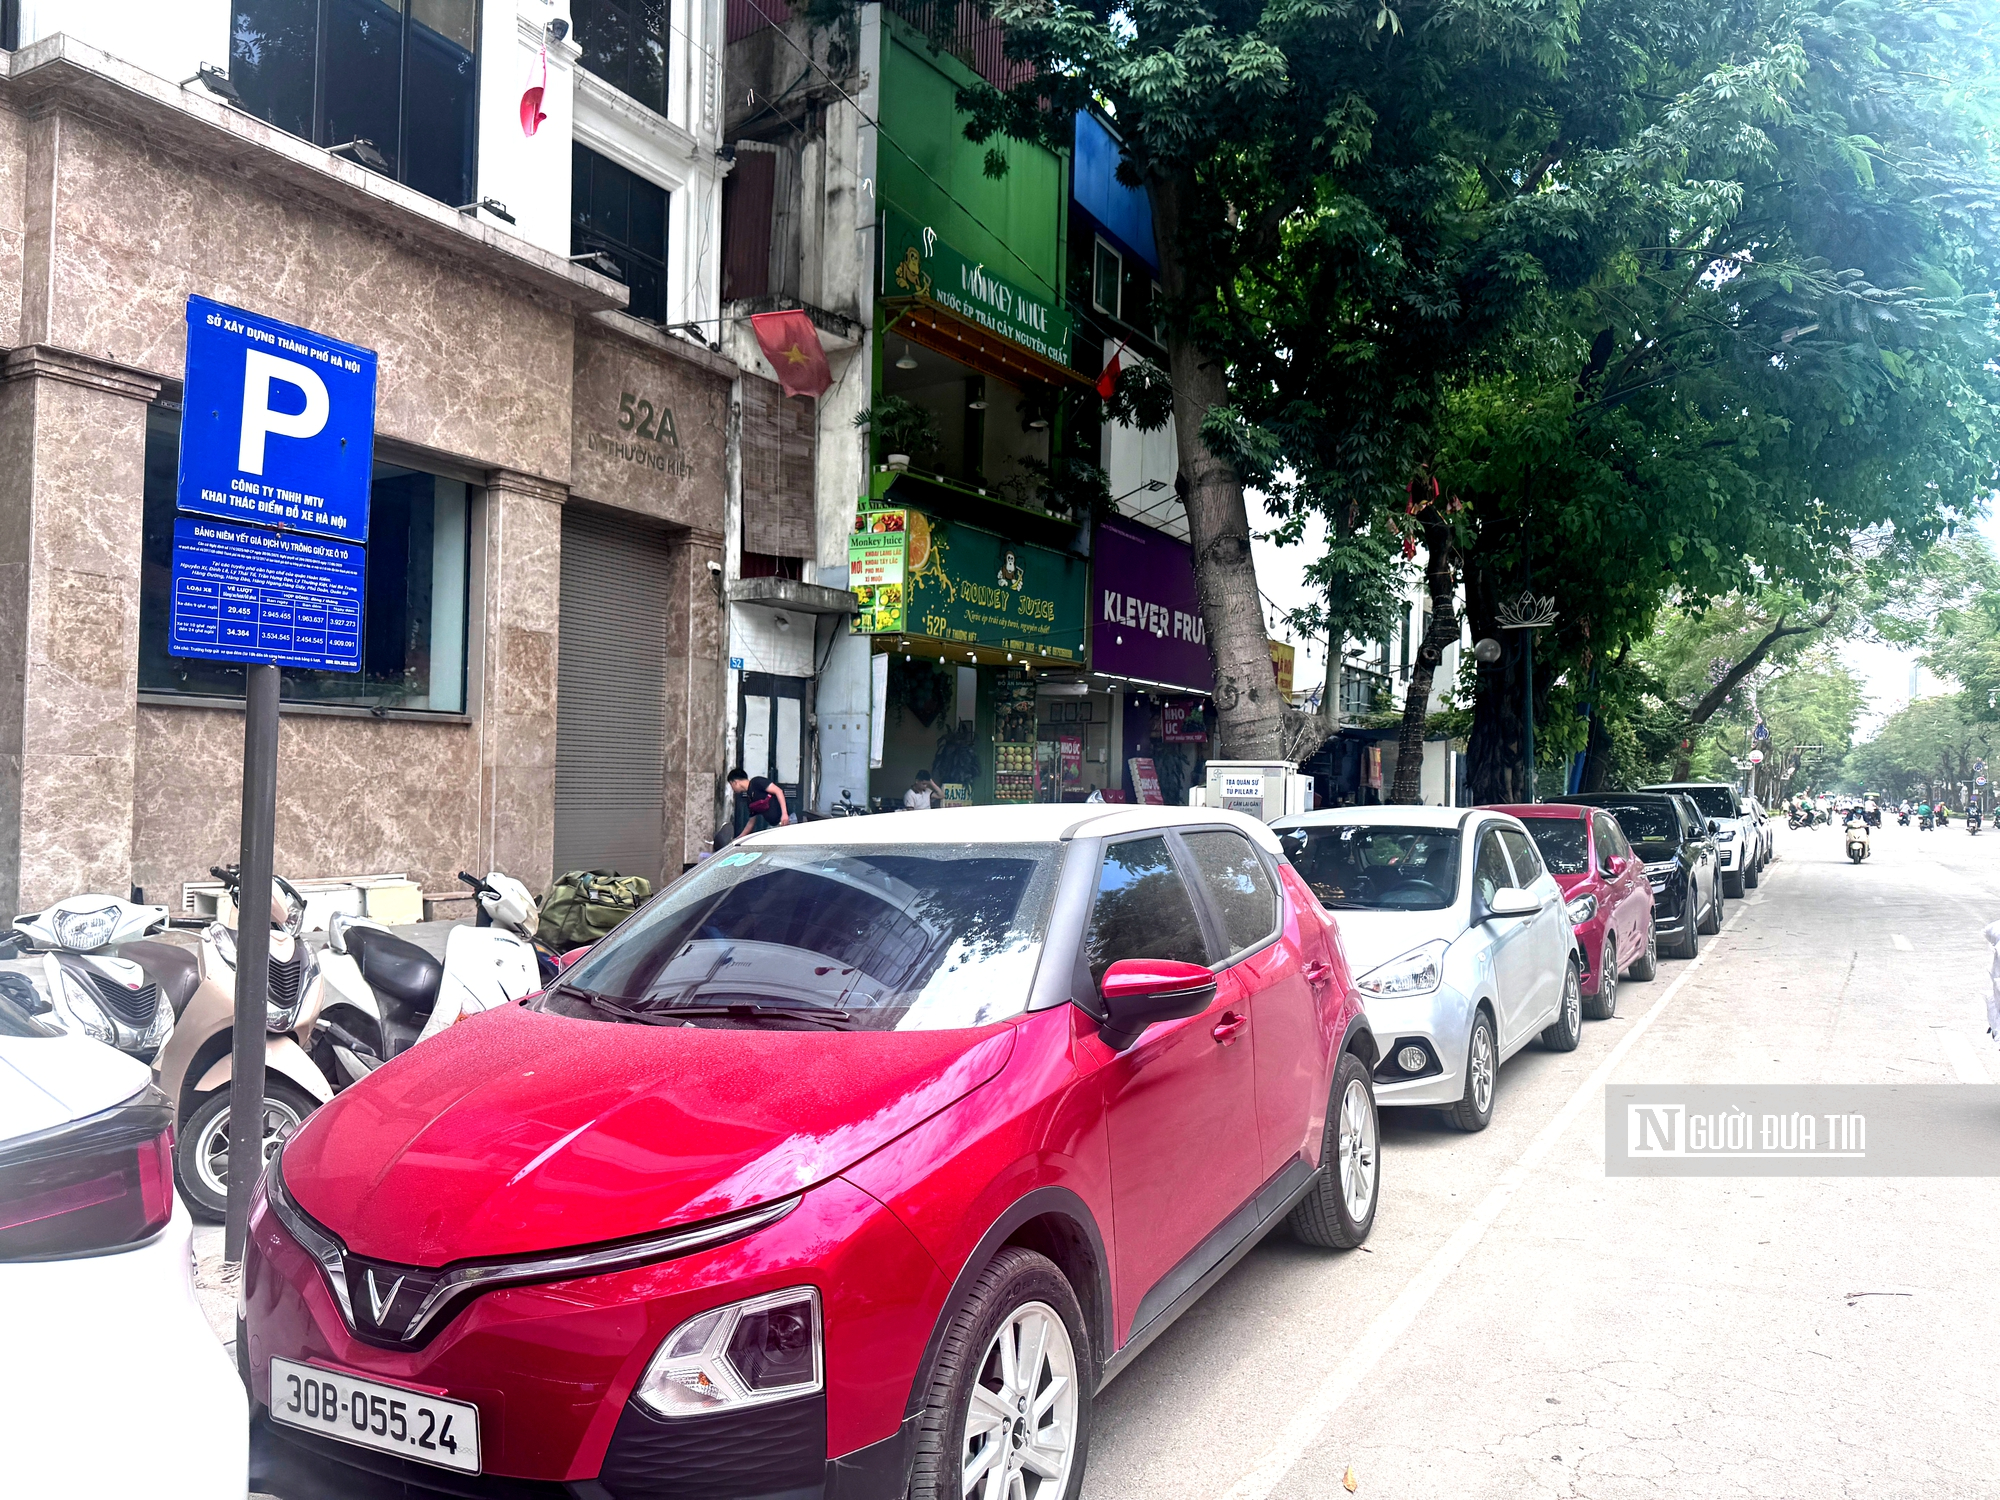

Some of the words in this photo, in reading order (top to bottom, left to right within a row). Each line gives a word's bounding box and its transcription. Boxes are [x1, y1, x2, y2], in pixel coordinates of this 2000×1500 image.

[962, 263, 1013, 316] MONKEY
[1016, 296, 1047, 333] JUICE
[937, 289, 961, 312] NƯỚC
[963, 301, 974, 318] ÉP
[975, 310, 995, 330] TRÁI
[997, 320, 1013, 338] CÂY
[1015, 329, 1046, 356] NGUYÊN
[1048, 346, 1067, 365] CHẤT
[207, 313, 222, 327] SỞ
[224, 321, 245, 335] XÂY
[247, 326, 275, 344] DỰNG
[277, 336, 308, 356] THÀNH
[310, 347, 329, 363] PHỐ
[331, 356, 343, 368] HÀ
[345, 360, 361, 373] NỘI
[238, 348, 330, 476] P
[617, 391, 680, 449] 52A
[606, 442, 666, 472] THƯỜNG
[667, 459, 693, 481] KIỆT
[231, 479, 259, 495] CÔNG
[262, 485, 274, 497] TY
[276, 489, 302, 503] TNHH
[304, 494, 324, 508] MTV
[202, 489, 227, 504] KHAI
[230, 494, 256, 510] THÁC
[258, 499, 283, 515] ĐIỂM
[286, 505, 299, 519] ĐỖ
[302, 511, 314, 521] XE
[316, 512, 329, 525] HÀ
[331, 516, 347, 530] NỘI
[194, 526, 214, 537] BẢNG
[215, 530, 234, 541] NIÊM
[235, 533, 249, 543] YẾT
[249, 535, 261, 545] GIÁ
[262, 537, 279, 548] DỊCH
[280, 540, 289, 551] VỤ
[312, 546, 325, 555] GIỮ
[324, 548, 333, 557] XE
[333, 548, 339, 558] Ô
[339, 550, 348, 559] TÔ
[851, 537, 882, 547] Monkey
[883, 535, 902, 546] Juice
[851, 557, 863, 575] MỚI
[227, 605, 250, 615] 29.455
[961, 581, 1010, 612] MONKEY
[1018, 595, 1055, 622] JUICE
[1104, 590, 1169, 637] KLEVER
[926, 615, 947, 637] 52P
[732, 657, 742, 669] 52
[1164, 708, 1185, 720] NHO
[1165, 720, 1178, 734] ÚC
[1061, 742, 1072, 754] NHO
[945, 785, 966, 800] BÁNH
[1254, 788, 1259, 796] 2
[286, 1373, 458, 1455] 30B-055.24
